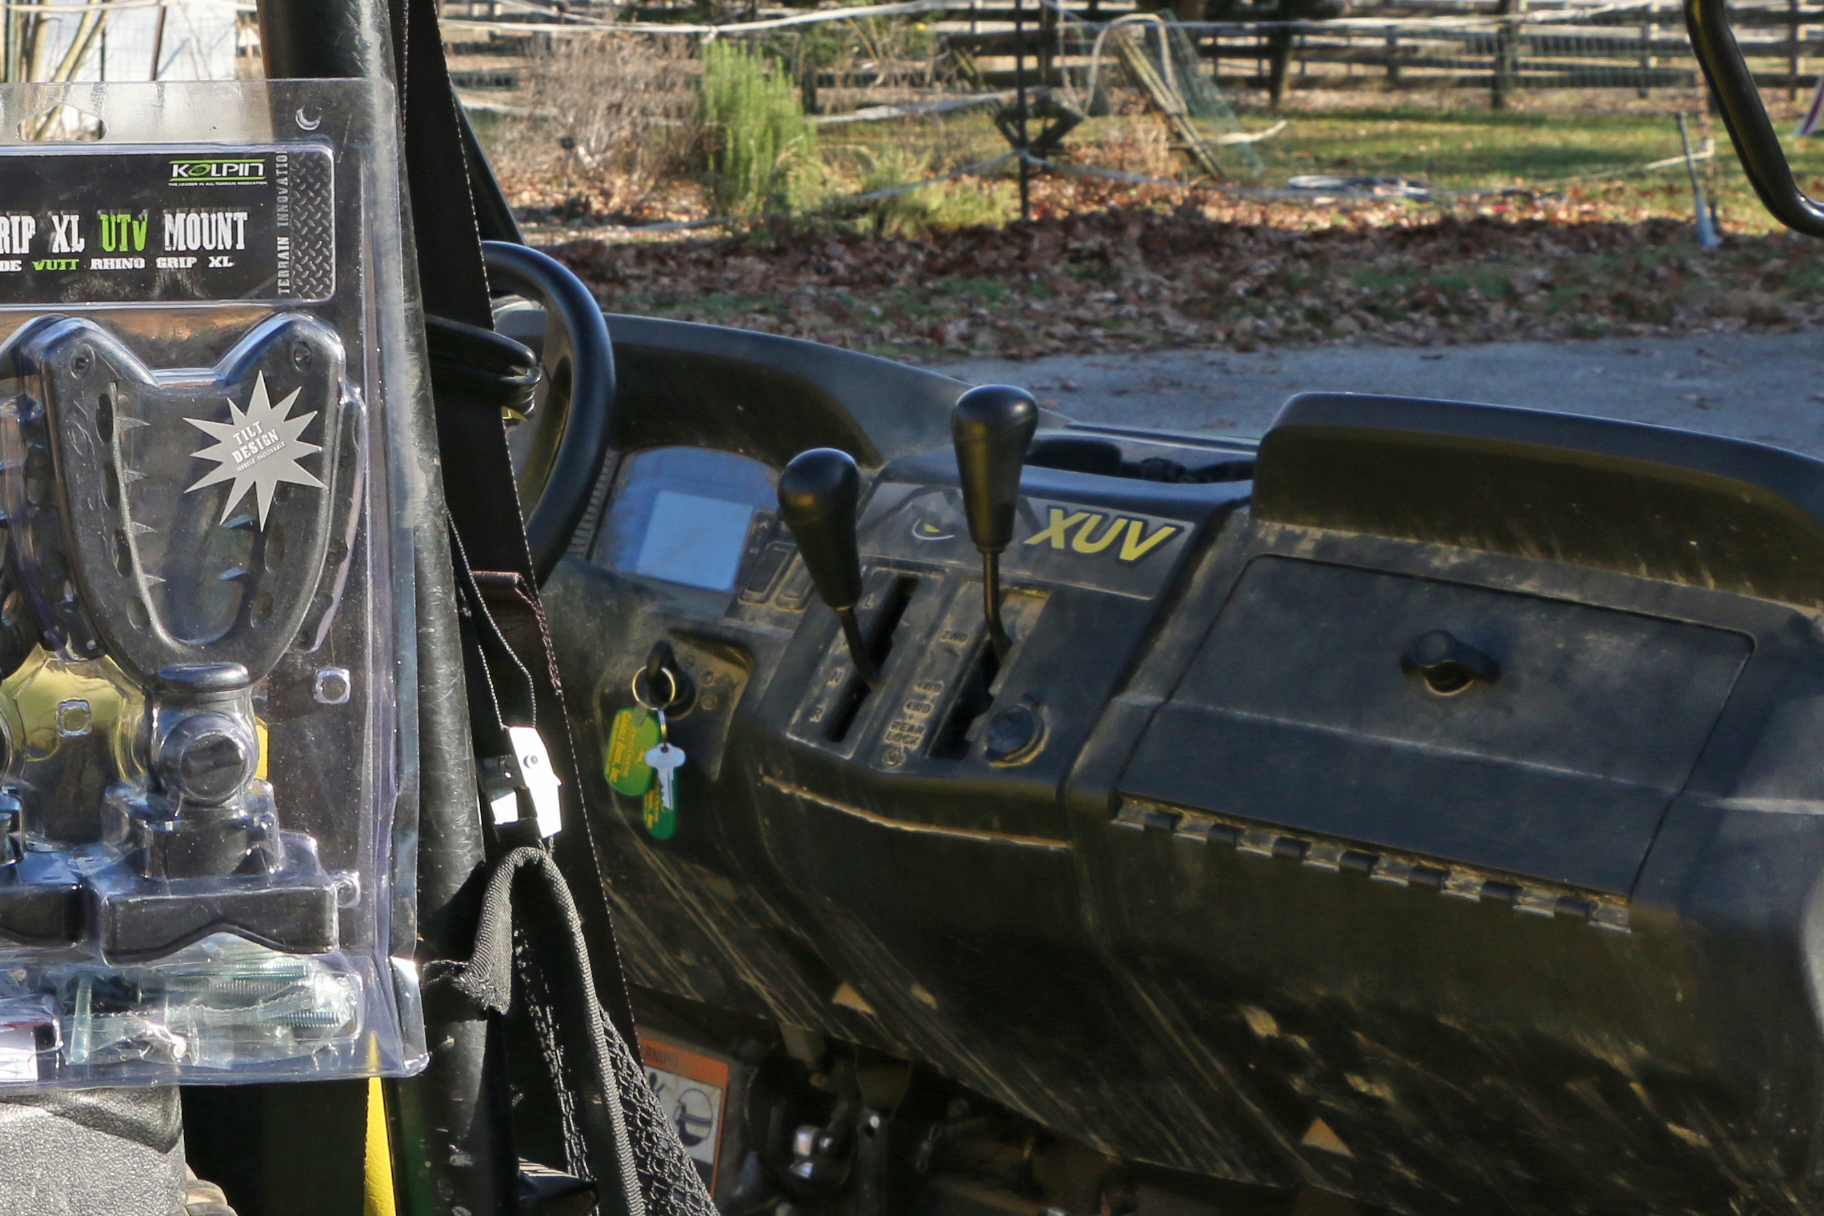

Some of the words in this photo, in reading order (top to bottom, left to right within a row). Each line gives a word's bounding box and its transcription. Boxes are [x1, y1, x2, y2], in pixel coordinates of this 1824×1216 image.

[172, 163, 264, 177] KOLPIN
[51, 214, 85, 253] XL
[100, 213, 149, 252] UTV
[164, 212, 248, 252] MOUNT
[32, 258, 79, 271] VUTT
[90, 257, 146, 270] RHINO
[156, 256, 197, 269] GRIP
[208, 256, 234, 269] XL
[277, 236, 290, 296] TERRAIN
[232, 421, 263, 445] TILT
[231, 429, 279, 464] DESIGN
[1023, 508, 1179, 561] XUV
[885, 731, 921, 748] LOCK
[890, 720, 925, 735] REAR
